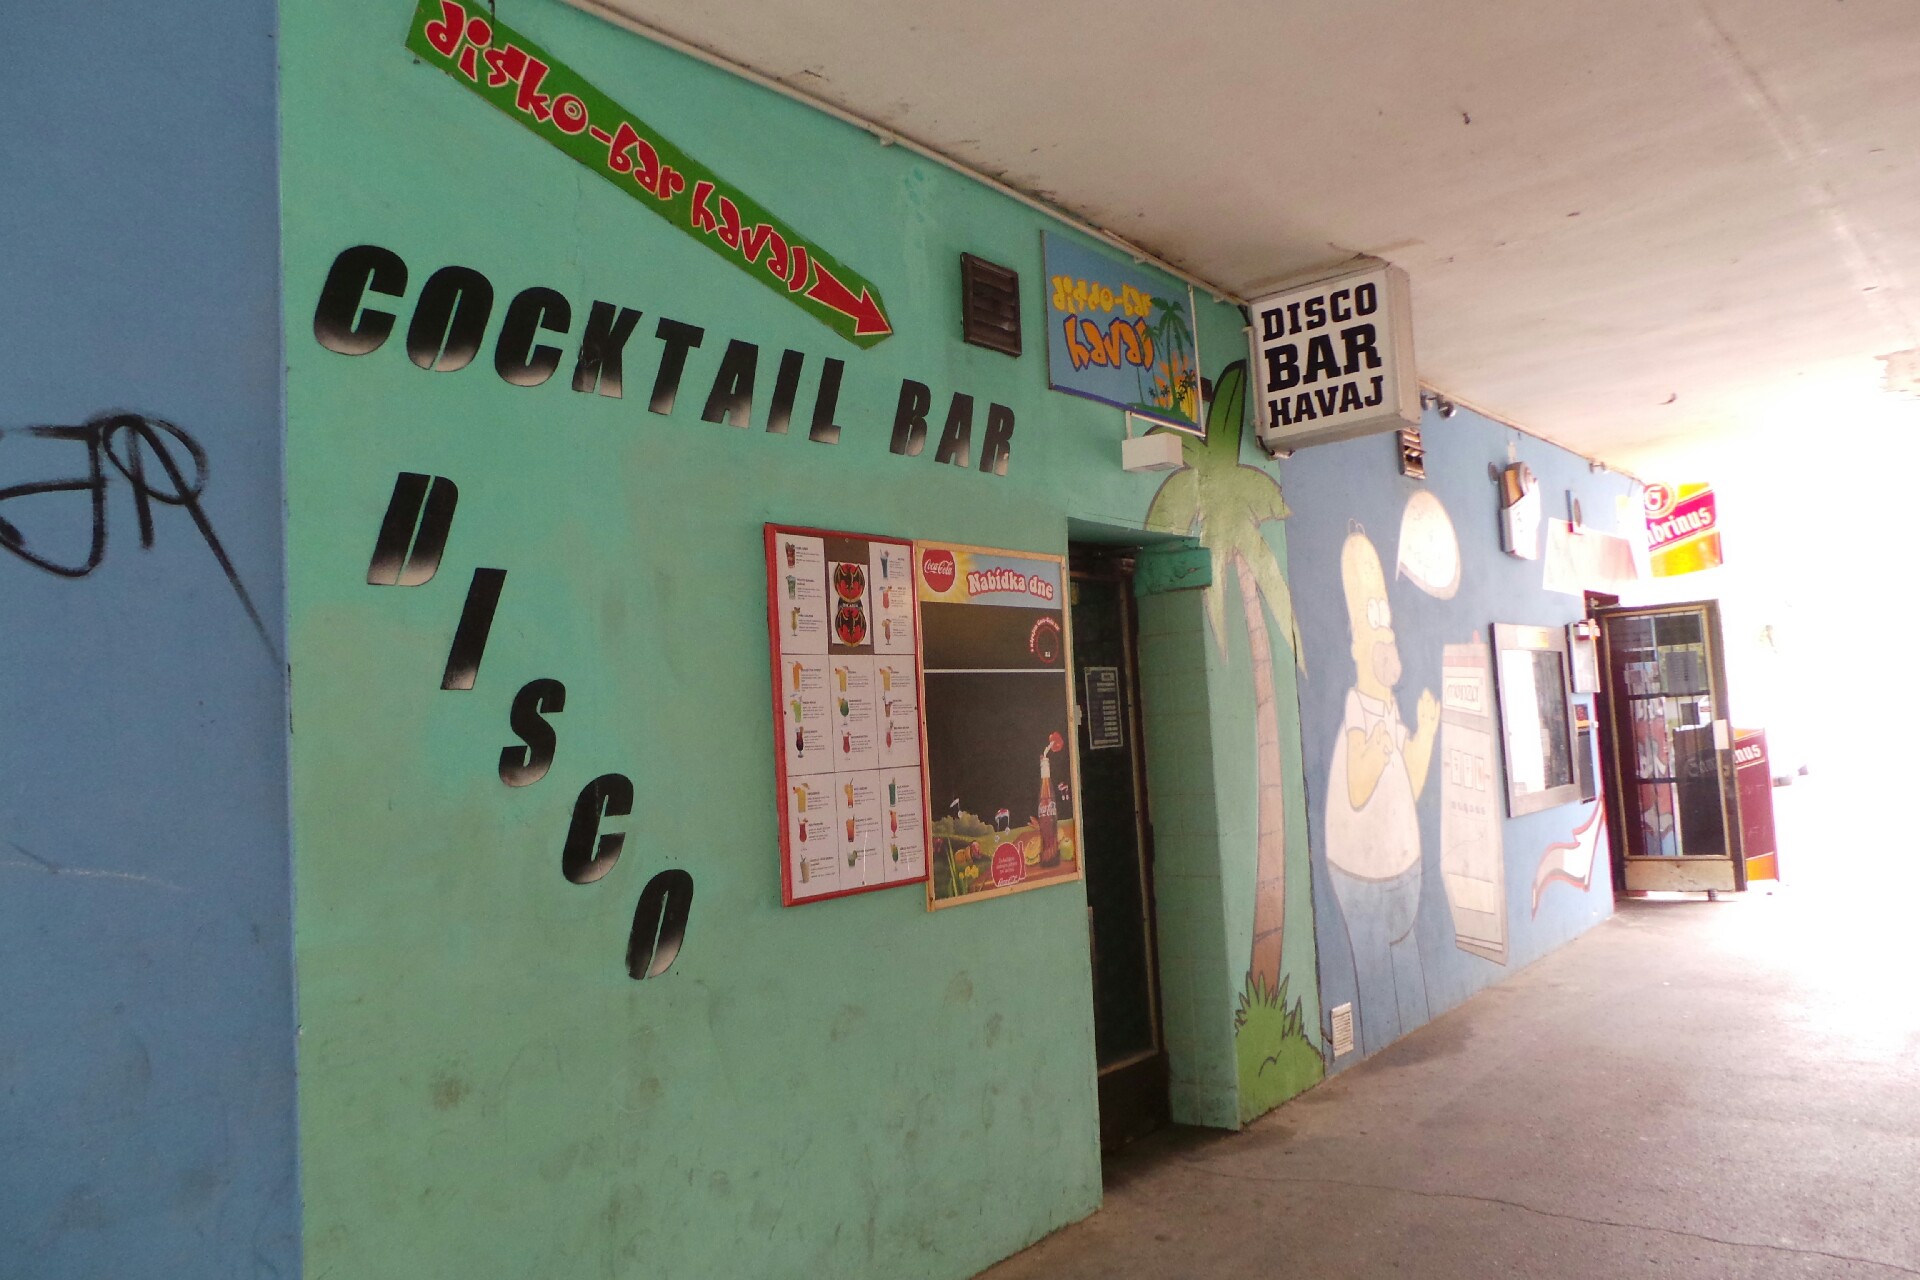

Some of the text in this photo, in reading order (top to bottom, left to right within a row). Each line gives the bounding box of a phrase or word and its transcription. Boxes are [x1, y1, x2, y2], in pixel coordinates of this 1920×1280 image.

[691, 180, 809, 293] havaj
[1260, 283, 1378, 342] DISCO
[313, 244, 1016, 475] COCKTAIL BAR
[1264, 323, 1384, 393] BAR
[1267, 374, 1384, 428] HAVAJ
[966, 567, 1054, 601] Nabídka dne
[369, 472, 693, 980] DISCO
